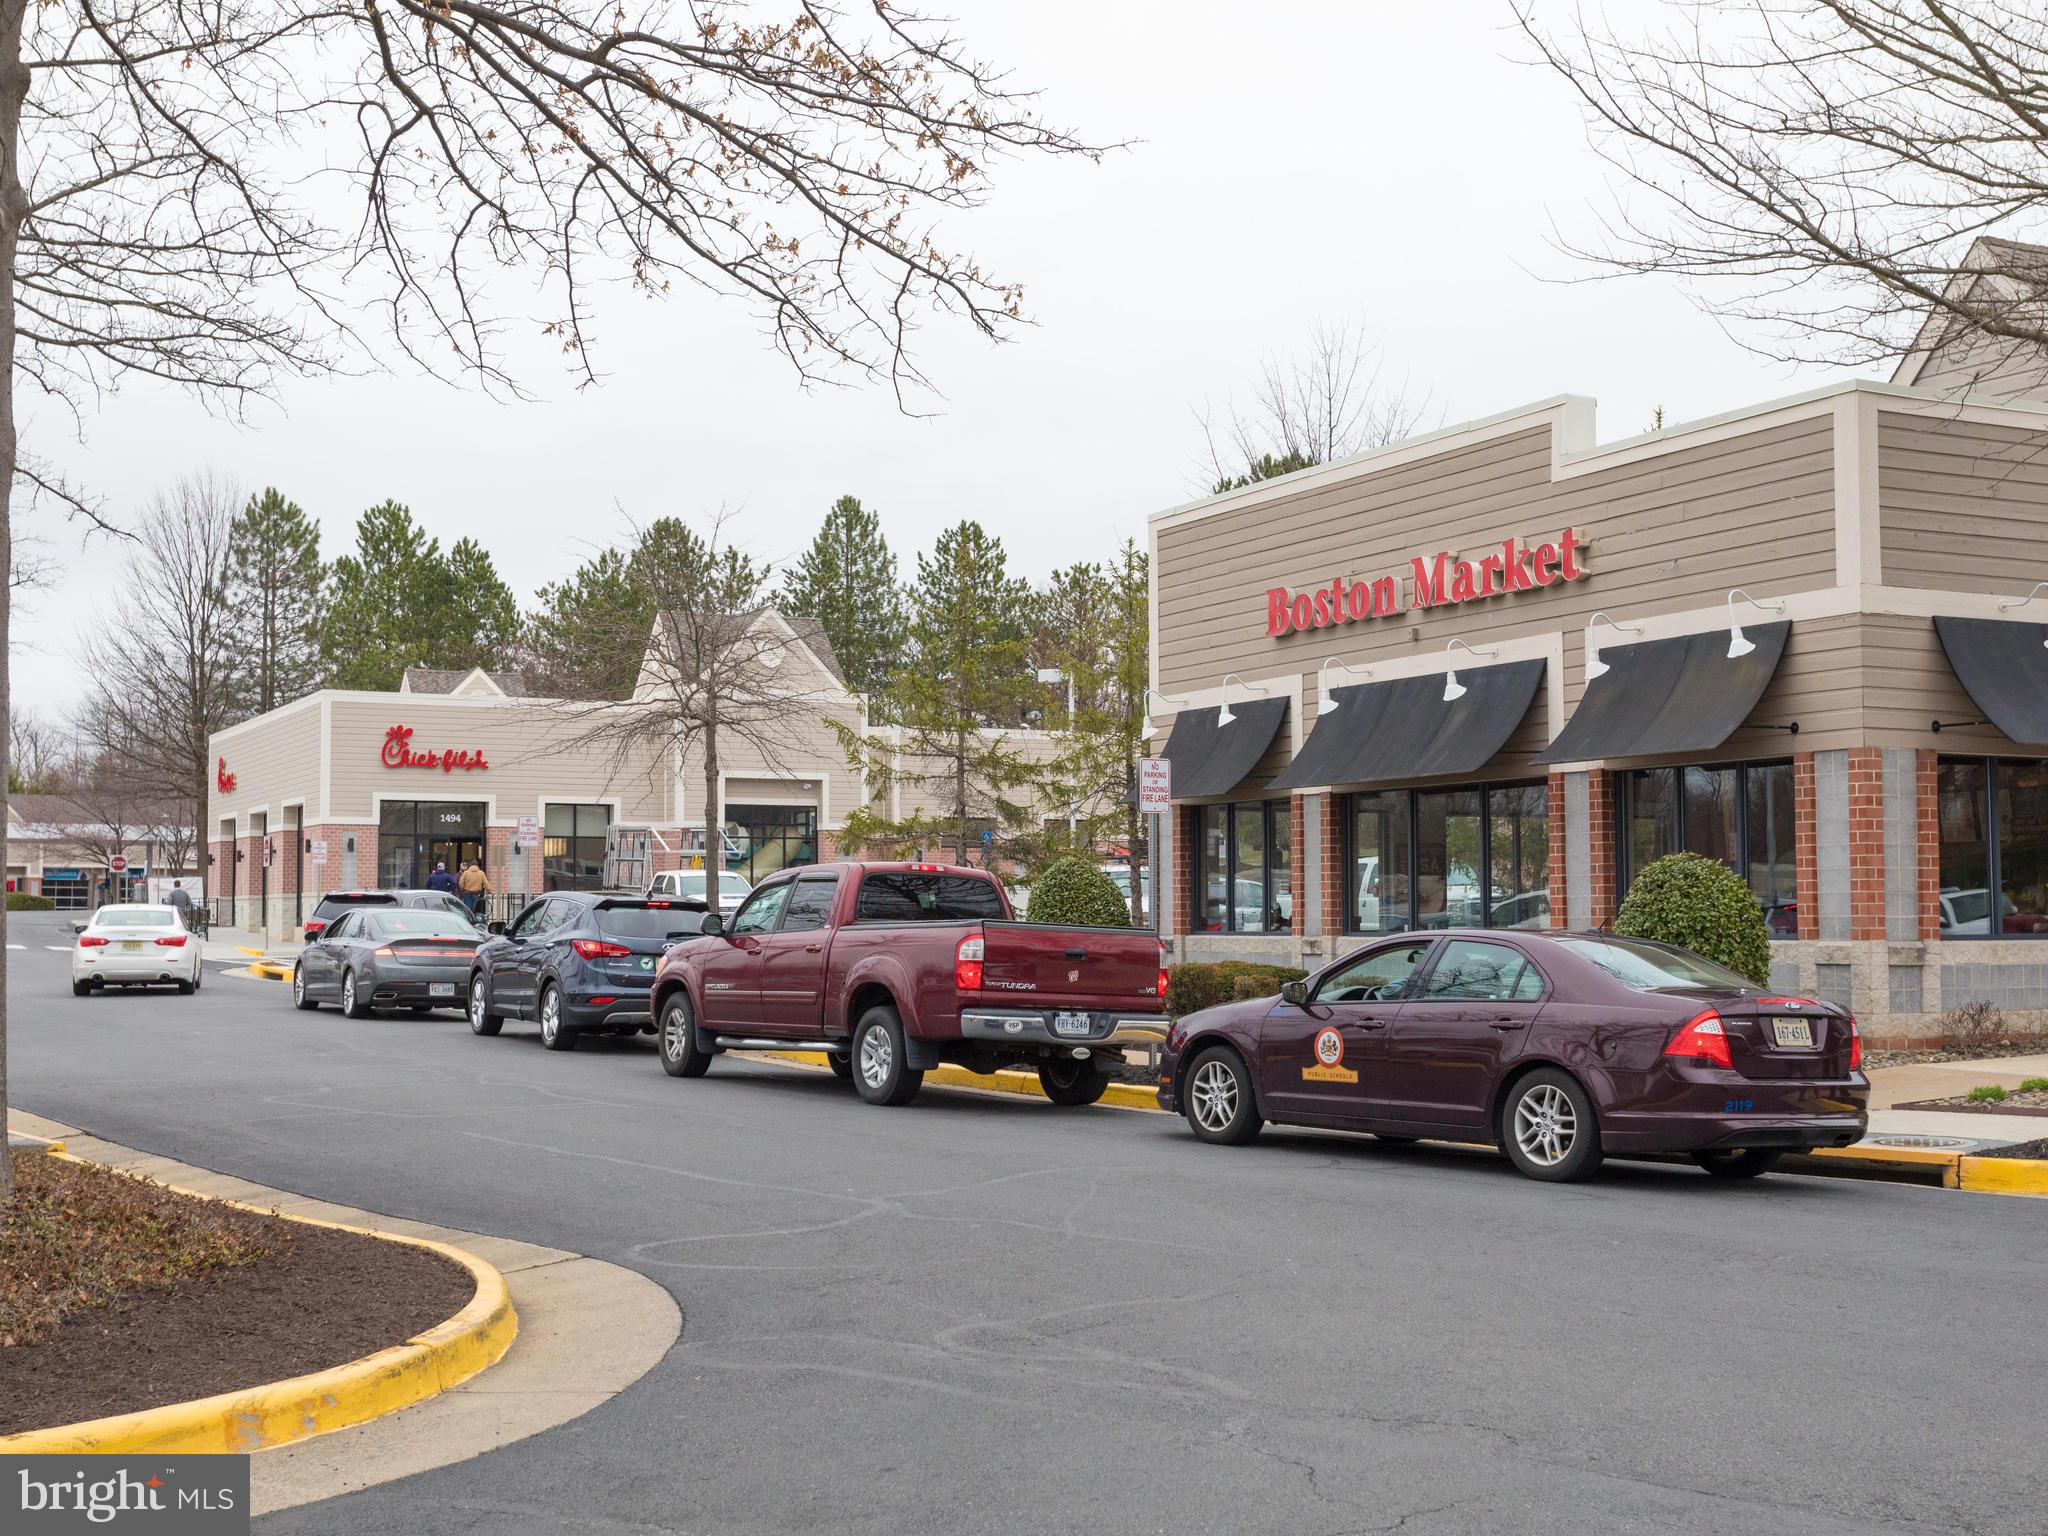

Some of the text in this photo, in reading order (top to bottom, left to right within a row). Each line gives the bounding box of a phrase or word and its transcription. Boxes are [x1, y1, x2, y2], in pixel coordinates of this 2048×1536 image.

[1265, 527, 1587, 638] Boston Market
[1143, 771, 1167, 779] PARKING
[1142, 785, 1168, 793] STANDING
[1142, 794, 1168, 803] FIRE LANE
[440, 814, 461, 822] 1494
[1001, 982, 1036, 990] TUNDRA
[1777, 1026, 1809, 1039] 167-451L
[1724, 1100, 1753, 1113] 2119
